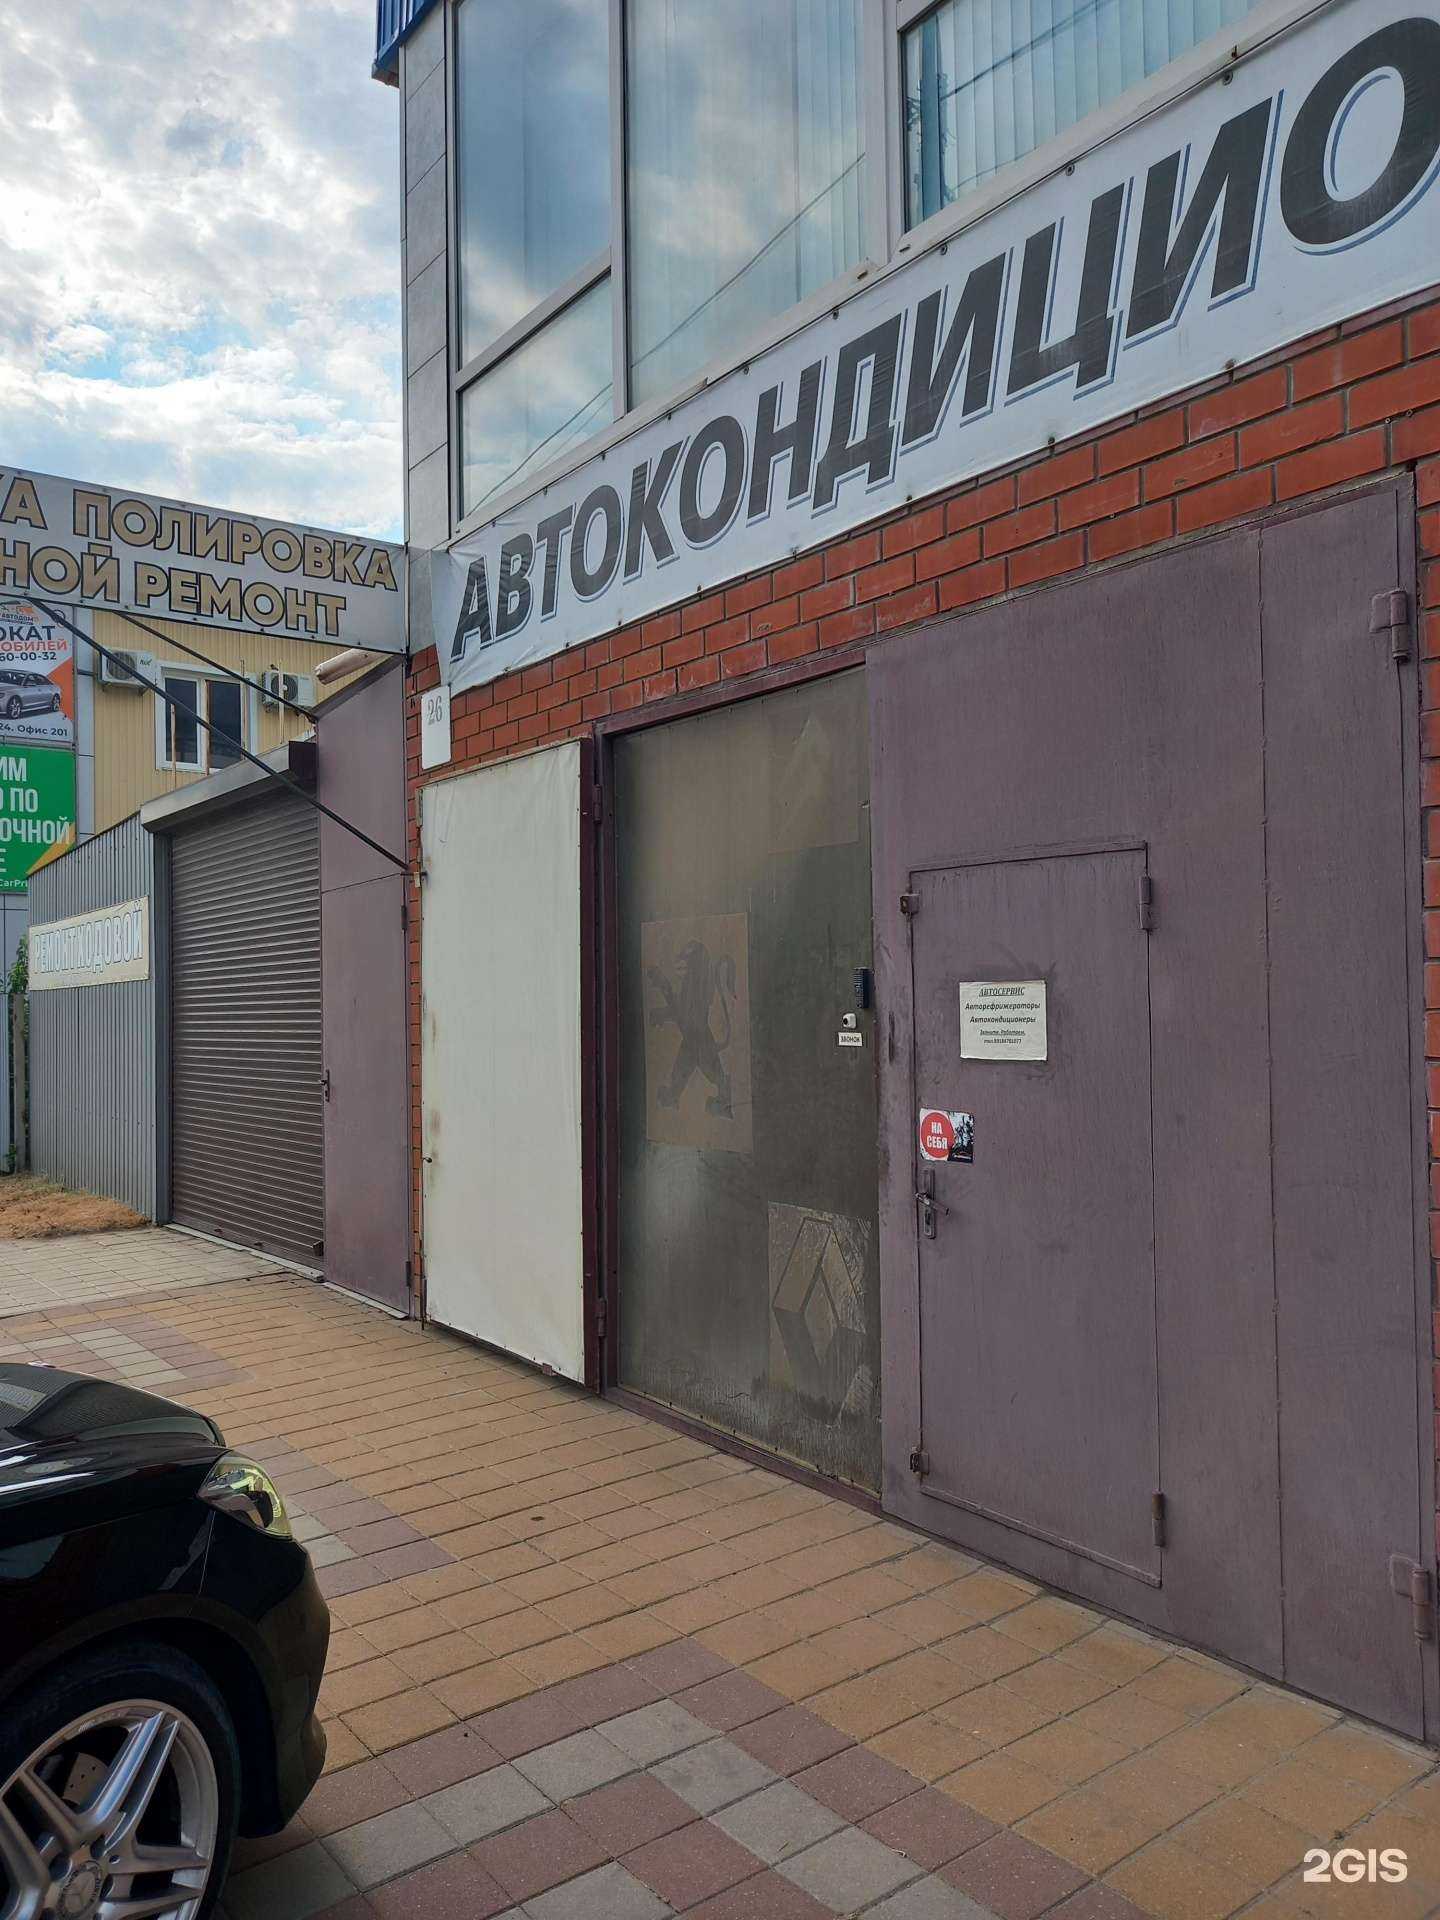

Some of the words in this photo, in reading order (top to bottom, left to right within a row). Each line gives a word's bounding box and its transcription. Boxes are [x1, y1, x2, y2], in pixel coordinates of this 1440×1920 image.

[450, 16, 1440, 664] АВТОКОНДИЦИО
[0, 474, 48, 531] А
[73, 488, 399, 592] ПОЛИРОВКА
[134, 561, 346, 637] РЕМОНТ
[427, 695, 442, 725] 26
[17, 724, 48, 735] Офис
[50, 728, 68, 737] 201
[10, 787, 39, 813] ПО
[0, 815, 70, 845] ОЧНОЙ
[979, 987, 1026, 997] АВТОСЕРВИС
[965, 1003, 1041, 1012] Авторефрижераторы
[970, 1016, 1036, 1024] Автокондиционеры
[931, 1121, 943, 1135] НА
[926, 1136, 948, 1149] СЕБЯ
